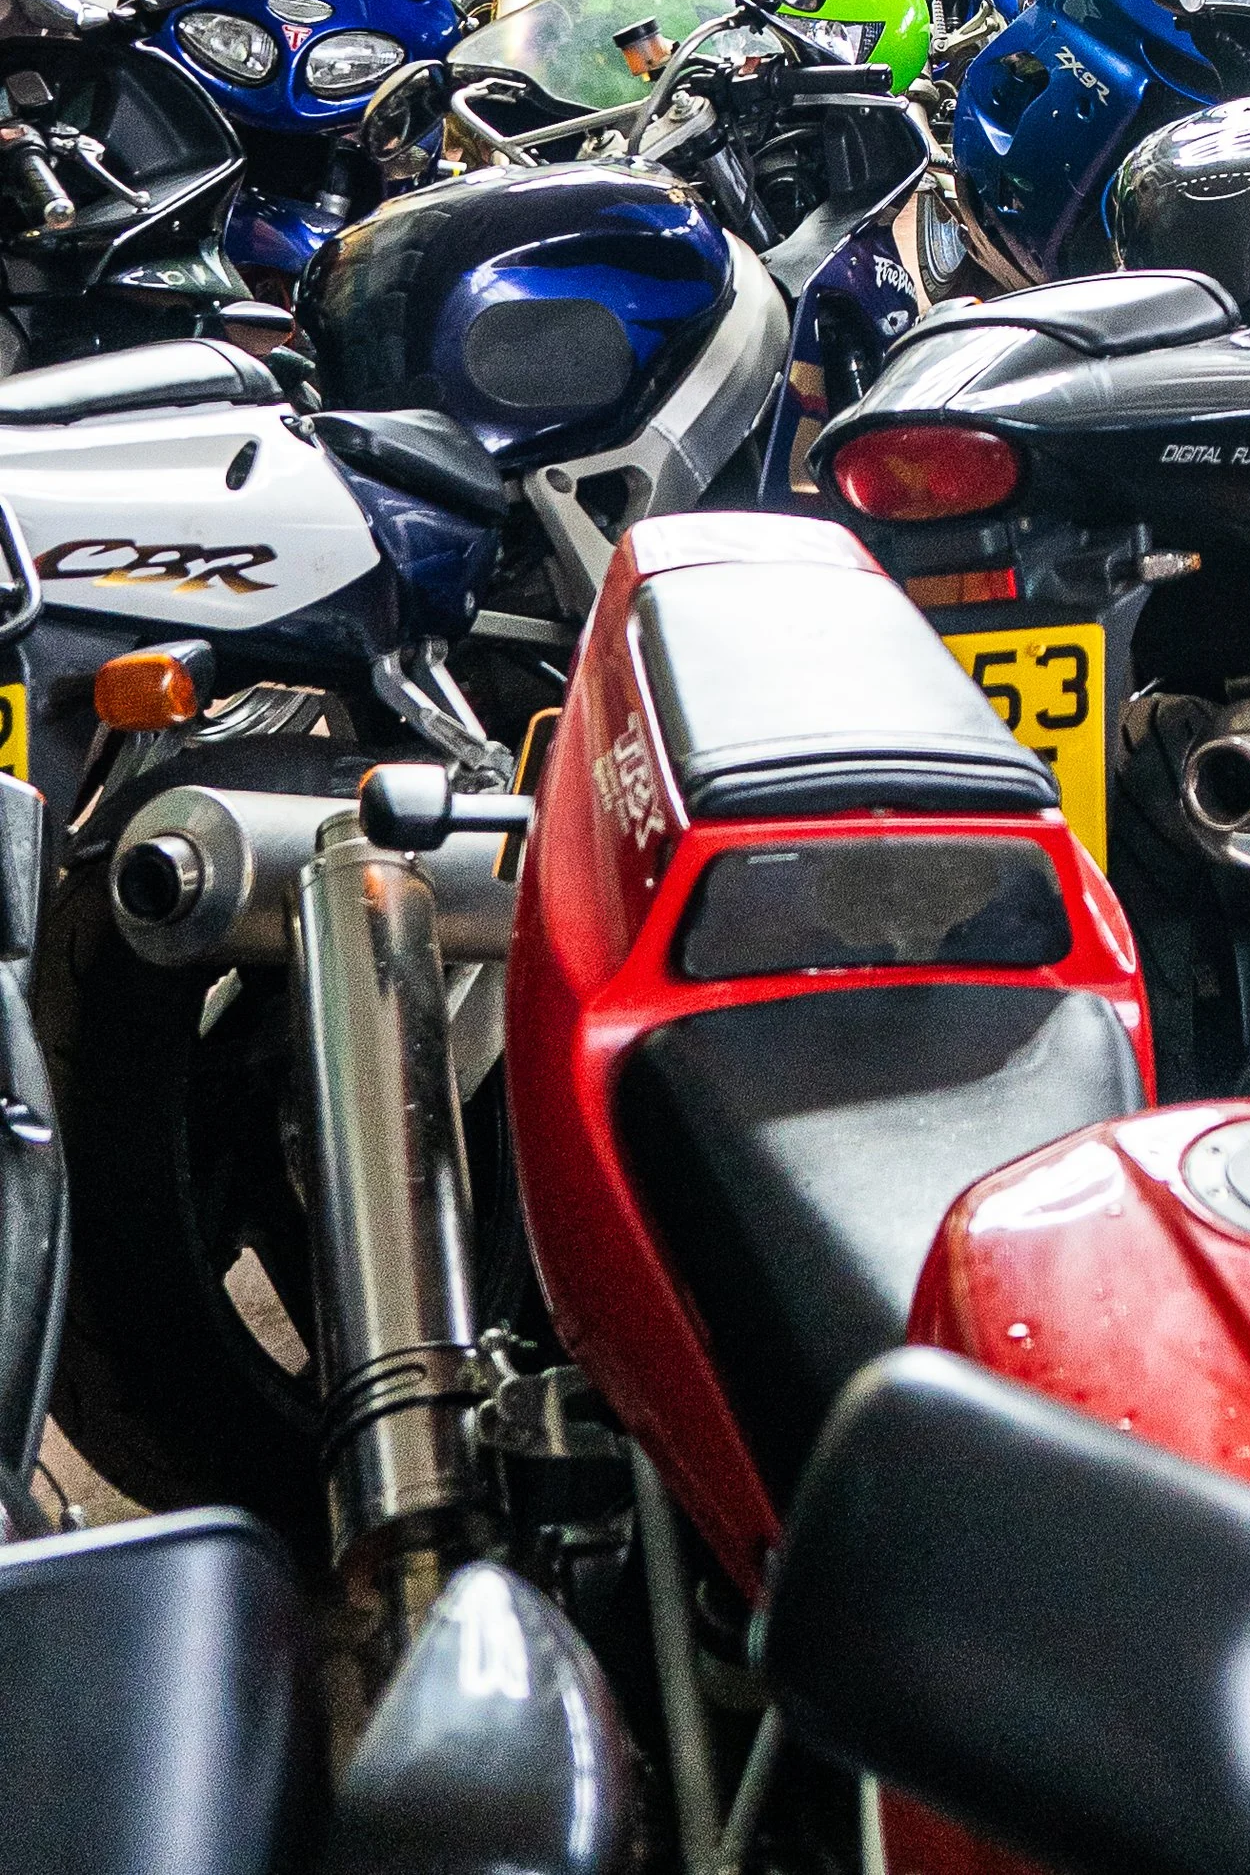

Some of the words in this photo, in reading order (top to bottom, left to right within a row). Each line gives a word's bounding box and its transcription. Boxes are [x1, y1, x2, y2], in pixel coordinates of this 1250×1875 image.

[1055, 45, 1110, 106] ZX-9R
[1160, 444, 1222, 463] DIGITAL
[33, 538, 278, 595] CBR
